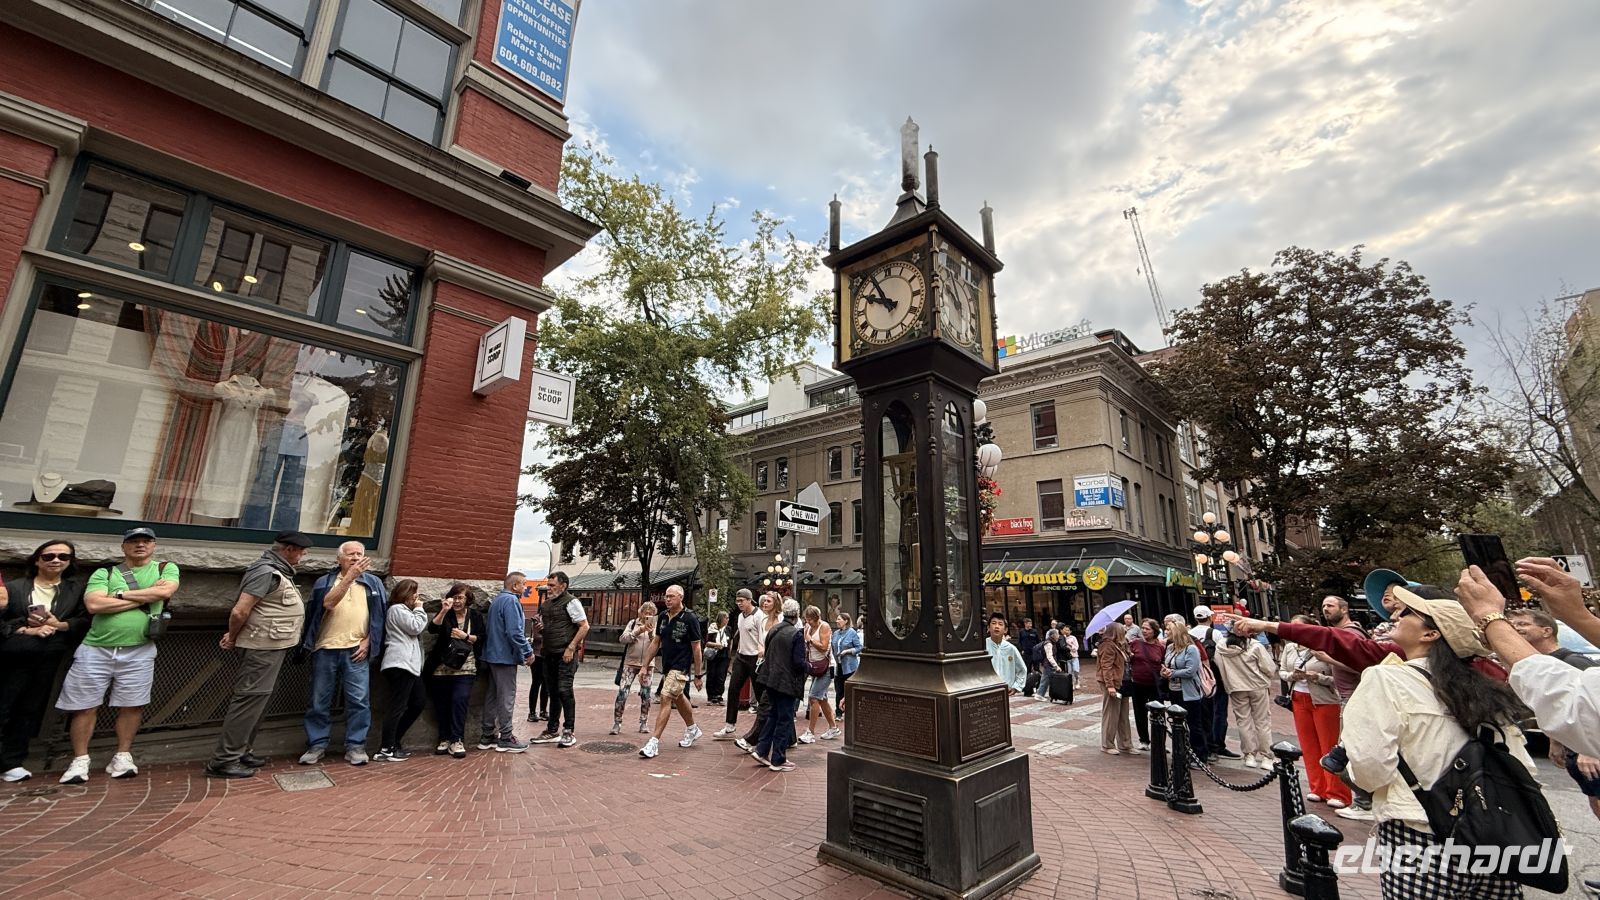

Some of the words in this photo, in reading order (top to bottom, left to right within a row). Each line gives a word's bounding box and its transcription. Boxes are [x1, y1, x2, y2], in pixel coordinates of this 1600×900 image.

[507, 3, 567, 48] OPPORTUNITIES
[507, 22, 537, 48] Robert
[539, 43, 562, 64] Tham
[511, 35, 535, 56] Marc
[499, 46, 562, 92] 604.609.0882
[1020, 319, 1092, 347] Microsoft
[537, 392, 562, 404] SCOOP
[547, 388, 562, 396] LATEST
[1089, 487, 1105, 495] LEASE
[790, 509, 803, 519] ONE
[805, 512, 818, 521] WAY
[1010, 519, 1022, 528] black
[1022, 518, 1033, 530] frog
[982, 569, 1003, 584] ee's
[1005, 570, 1077, 585] Donuts
